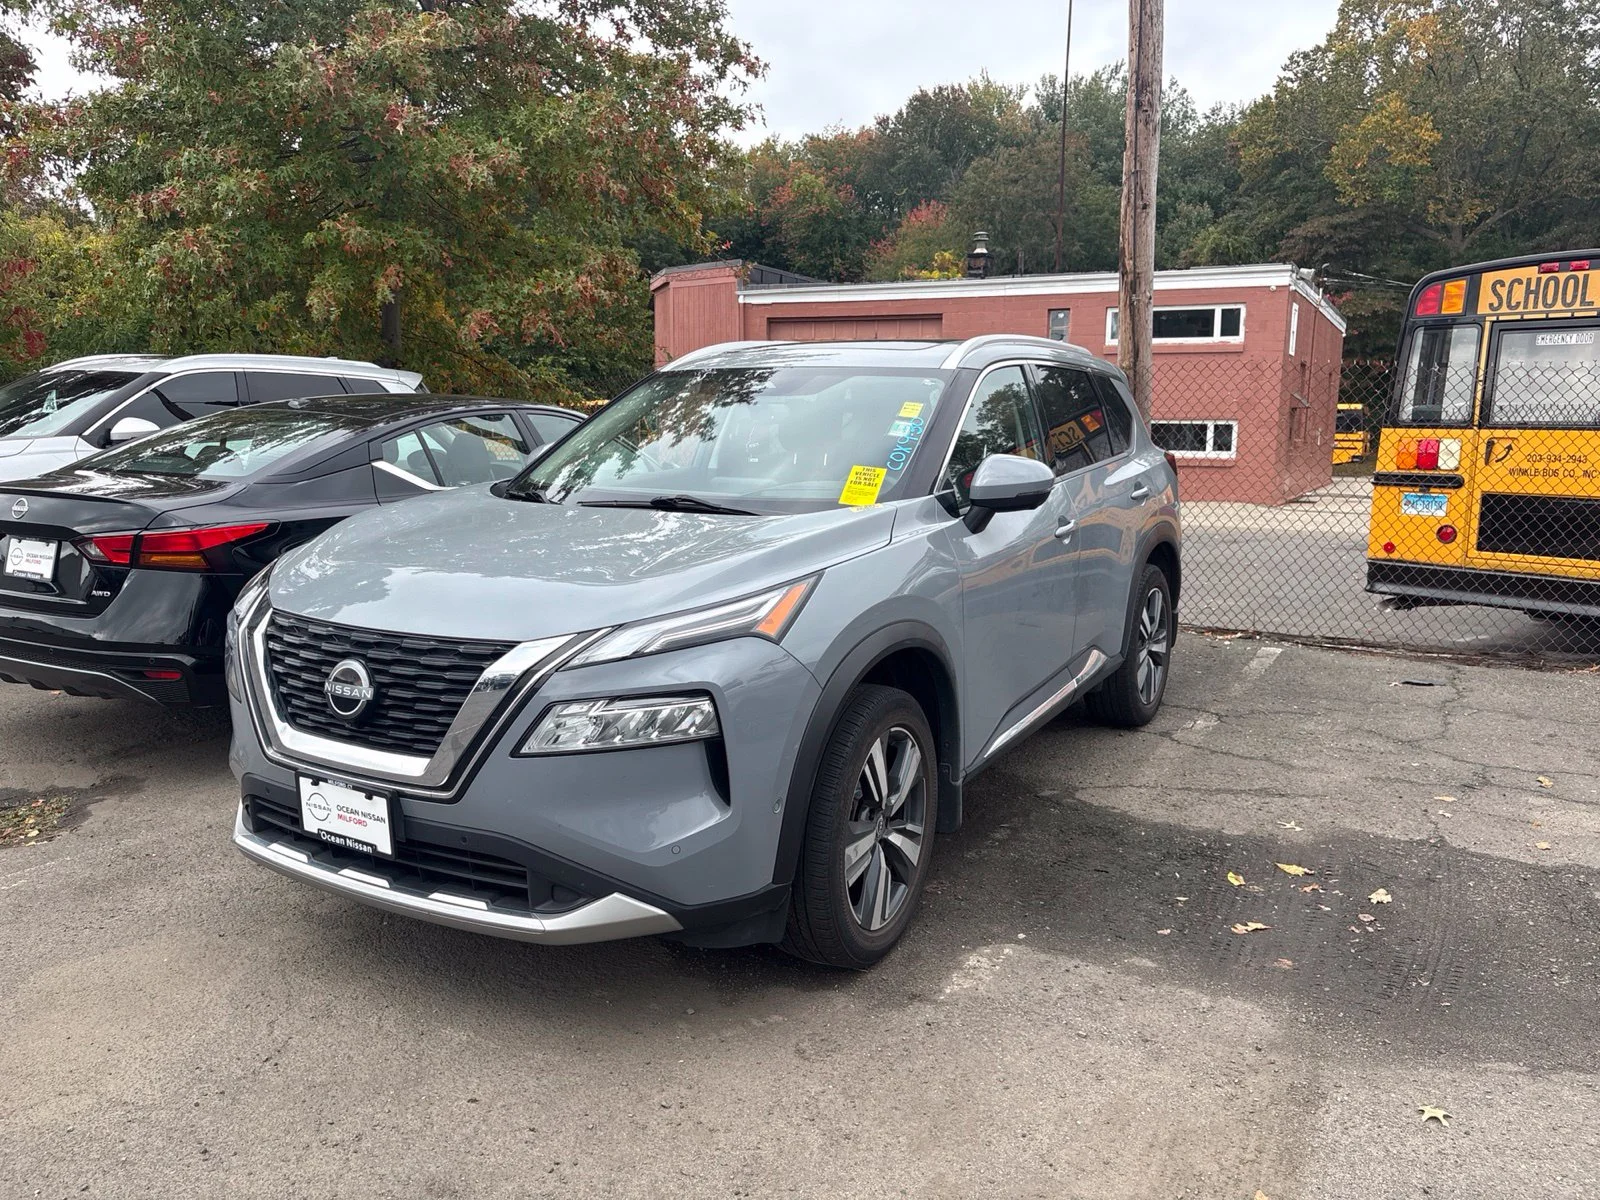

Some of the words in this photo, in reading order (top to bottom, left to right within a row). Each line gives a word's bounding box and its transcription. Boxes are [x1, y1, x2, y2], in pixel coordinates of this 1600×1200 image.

[1488, 273, 1595, 311] SCHOOL
[1536, 333, 1574, 345] EMERGENCY
[1575, 332, 1594, 344] DOOR
[887, 444, 912, 470] COX
[1526, 453, 1587, 464] 203-934-2943
[1508, 467, 1540, 477] WINKLE
[1542, 468, 1560, 478] BUS
[324, 681, 371, 698] NISSAN
[305, 801, 332, 813] NISSAN
[336, 804, 360, 817] OCEAN
[360, 810, 386, 824] NISSAN
[337, 813, 368, 828] MILFORD
